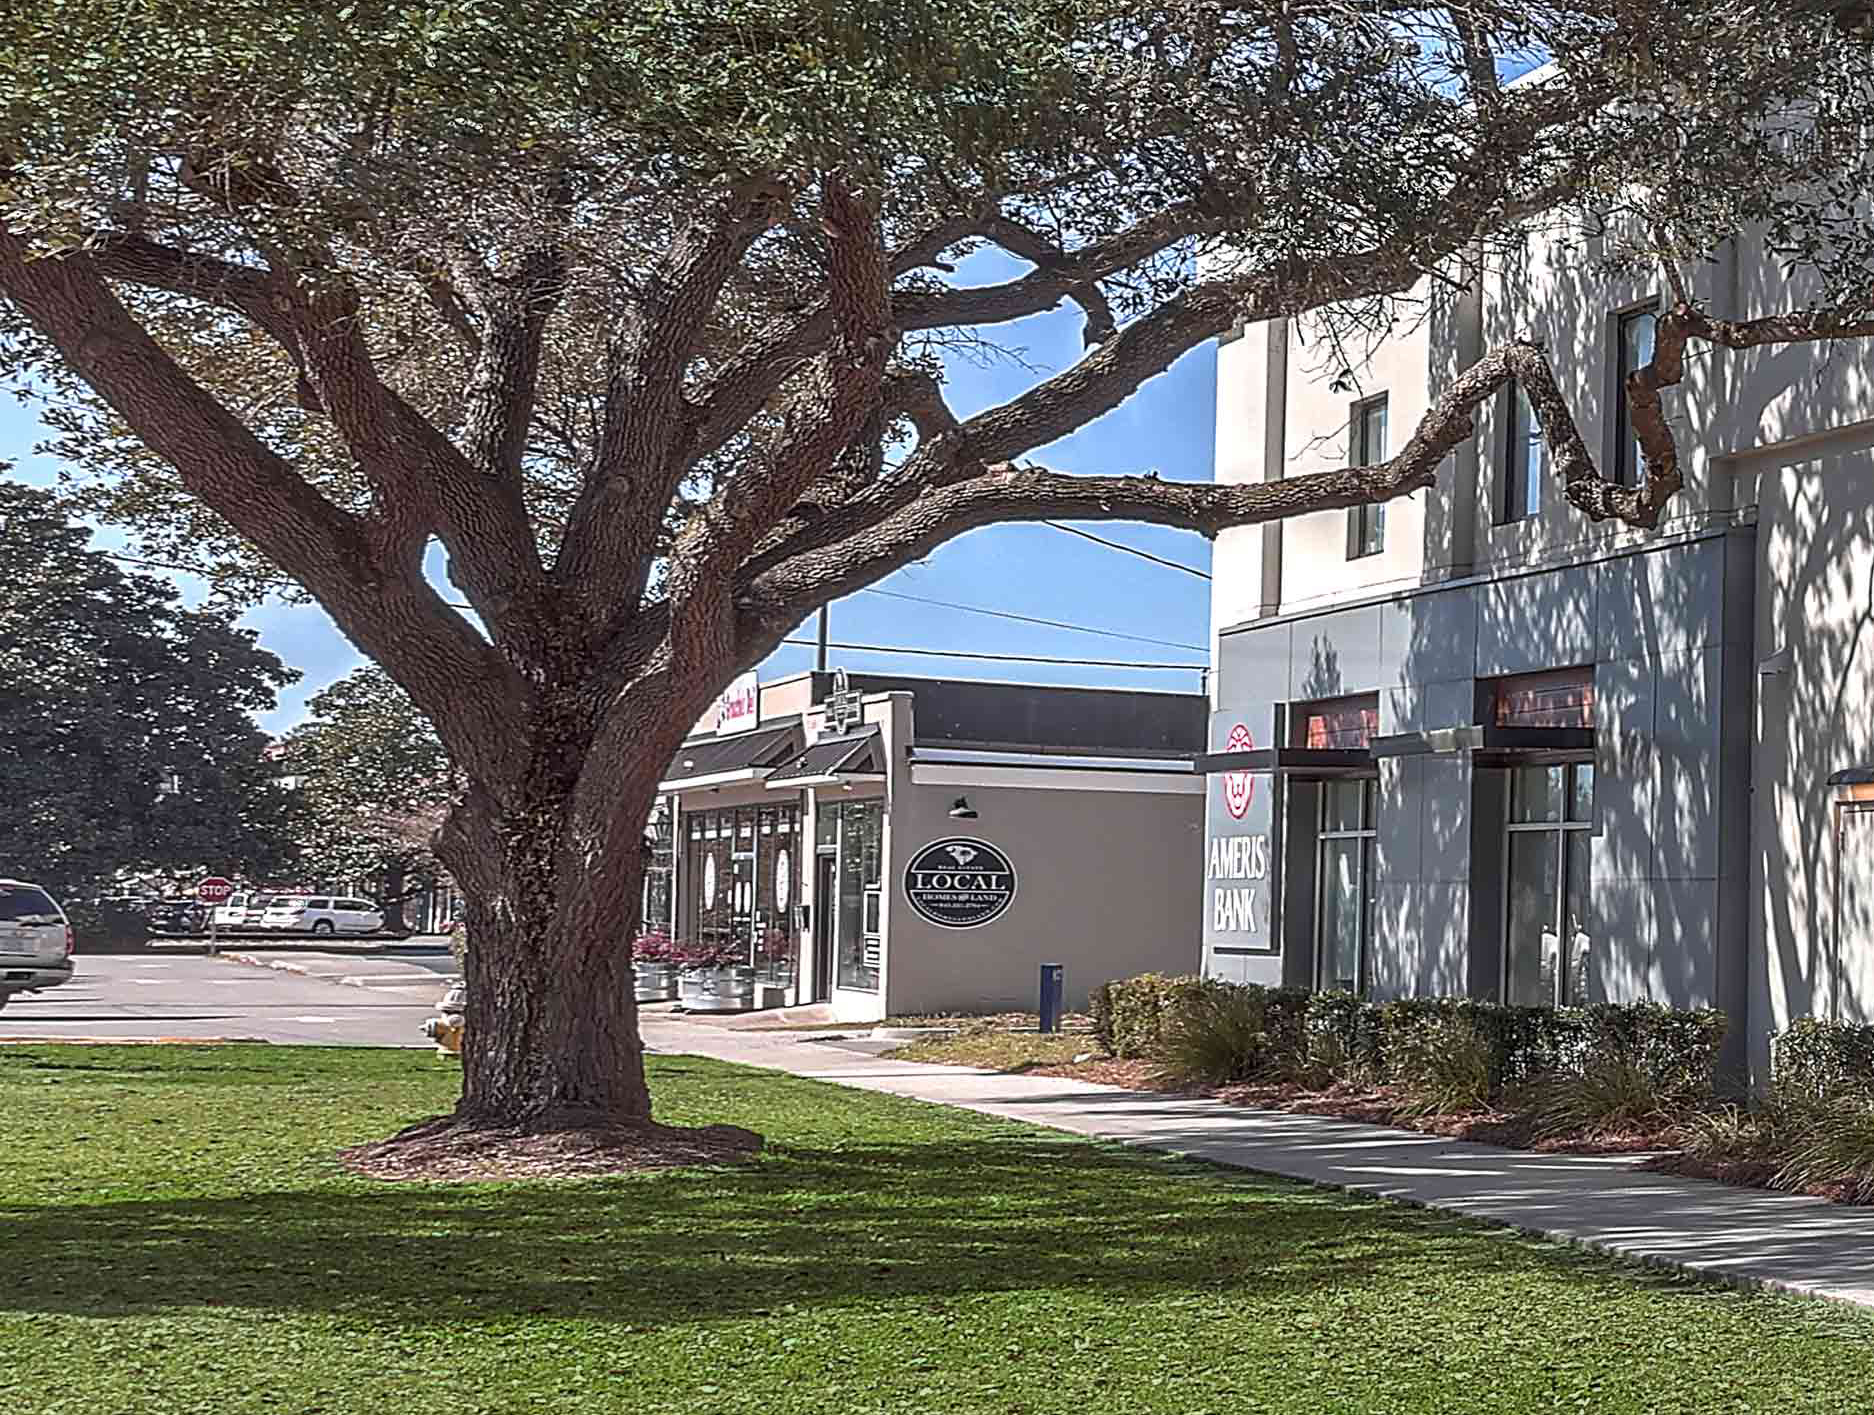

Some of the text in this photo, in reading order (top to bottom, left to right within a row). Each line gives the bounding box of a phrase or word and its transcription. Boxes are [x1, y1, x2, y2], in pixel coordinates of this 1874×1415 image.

[1207, 834, 1266, 880] AMERIS
[199, 885, 232, 896] STOP
[915, 873, 1006, 890] LOCAL
[1213, 887, 1257, 932] BANK
